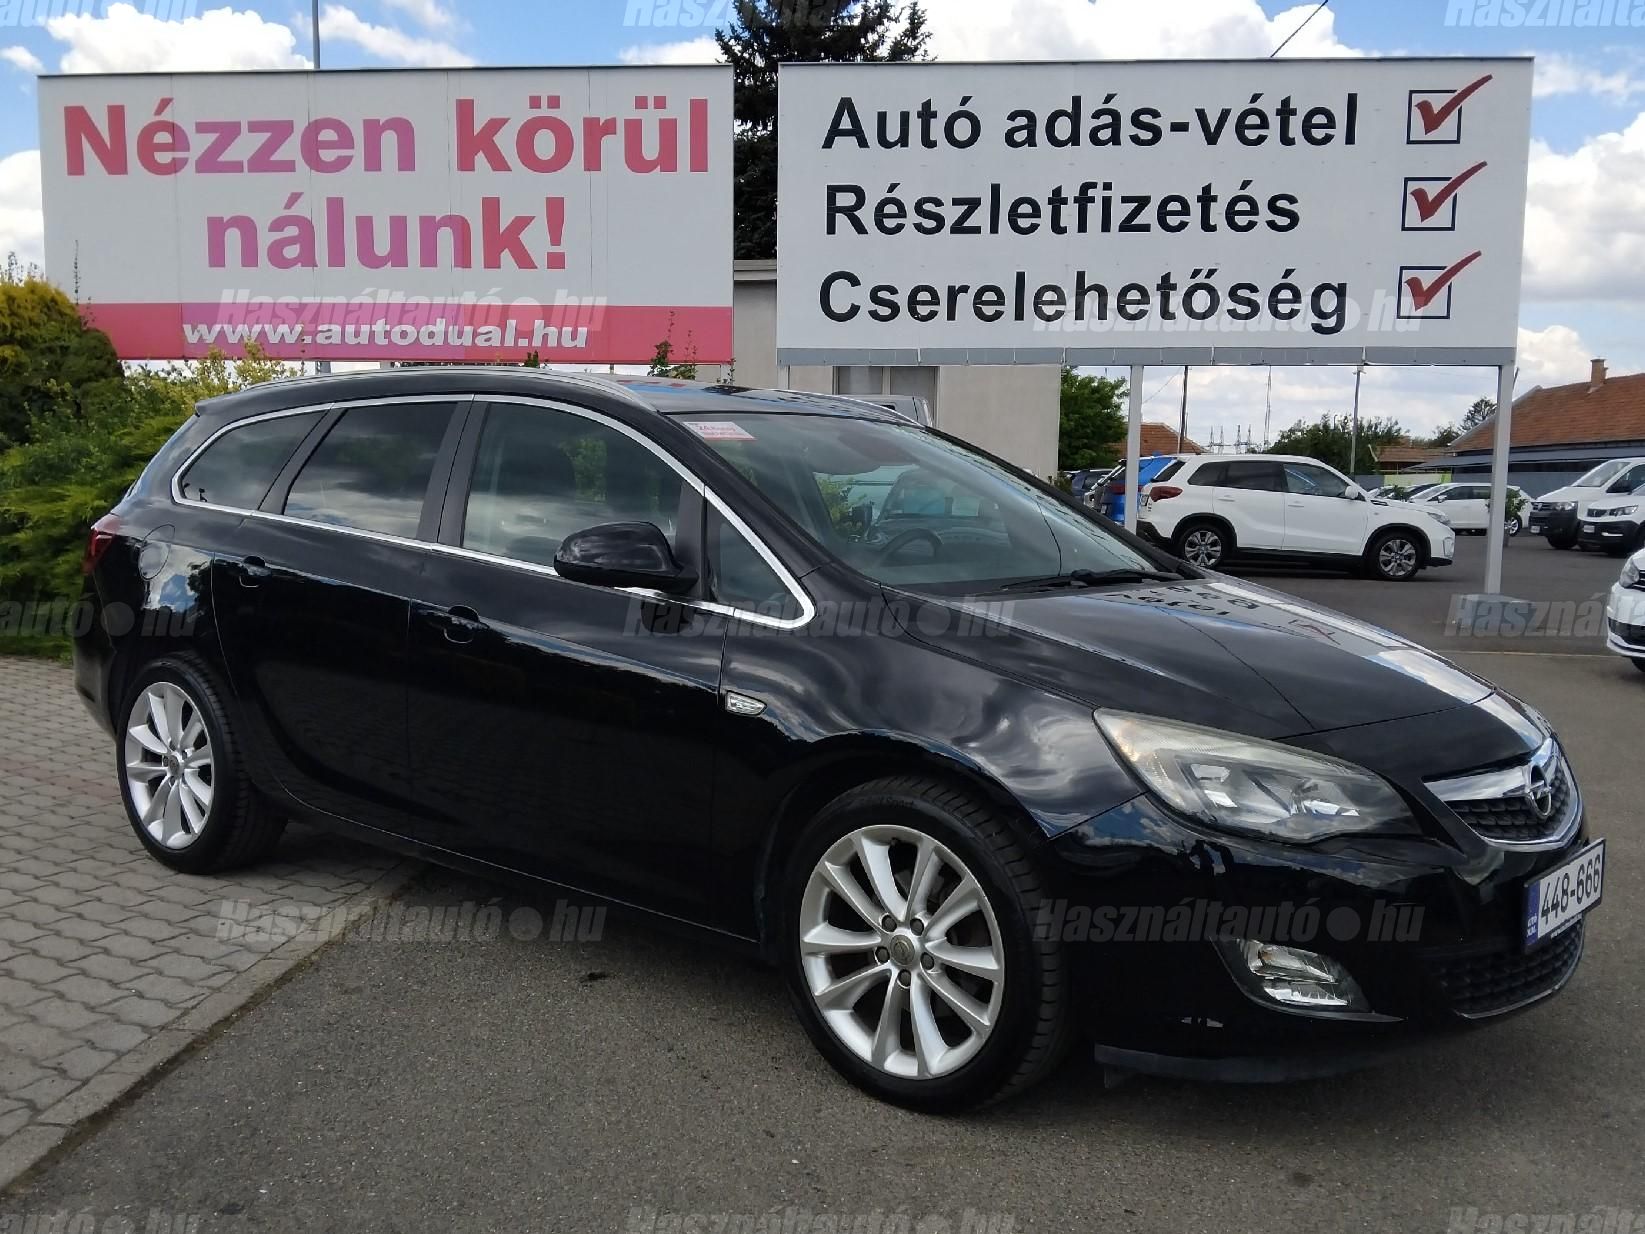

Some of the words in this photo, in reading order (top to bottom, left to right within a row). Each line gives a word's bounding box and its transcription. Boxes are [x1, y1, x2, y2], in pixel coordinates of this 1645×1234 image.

[63, 97, 416, 176] Nézzen
[456, 95, 708, 173] körül
[821, 94, 981, 149] Autó
[1004, 92, 1357, 148] adás-vétel
[206, 192, 566, 270] nálunk!
[826, 180, 1300, 236] Részletfizetés
[183, 318, 587, 350] www.autodual.hu
[818, 268, 1348, 334] Cserelehetőség
[1541, 854, 1600, 925] 448-666
